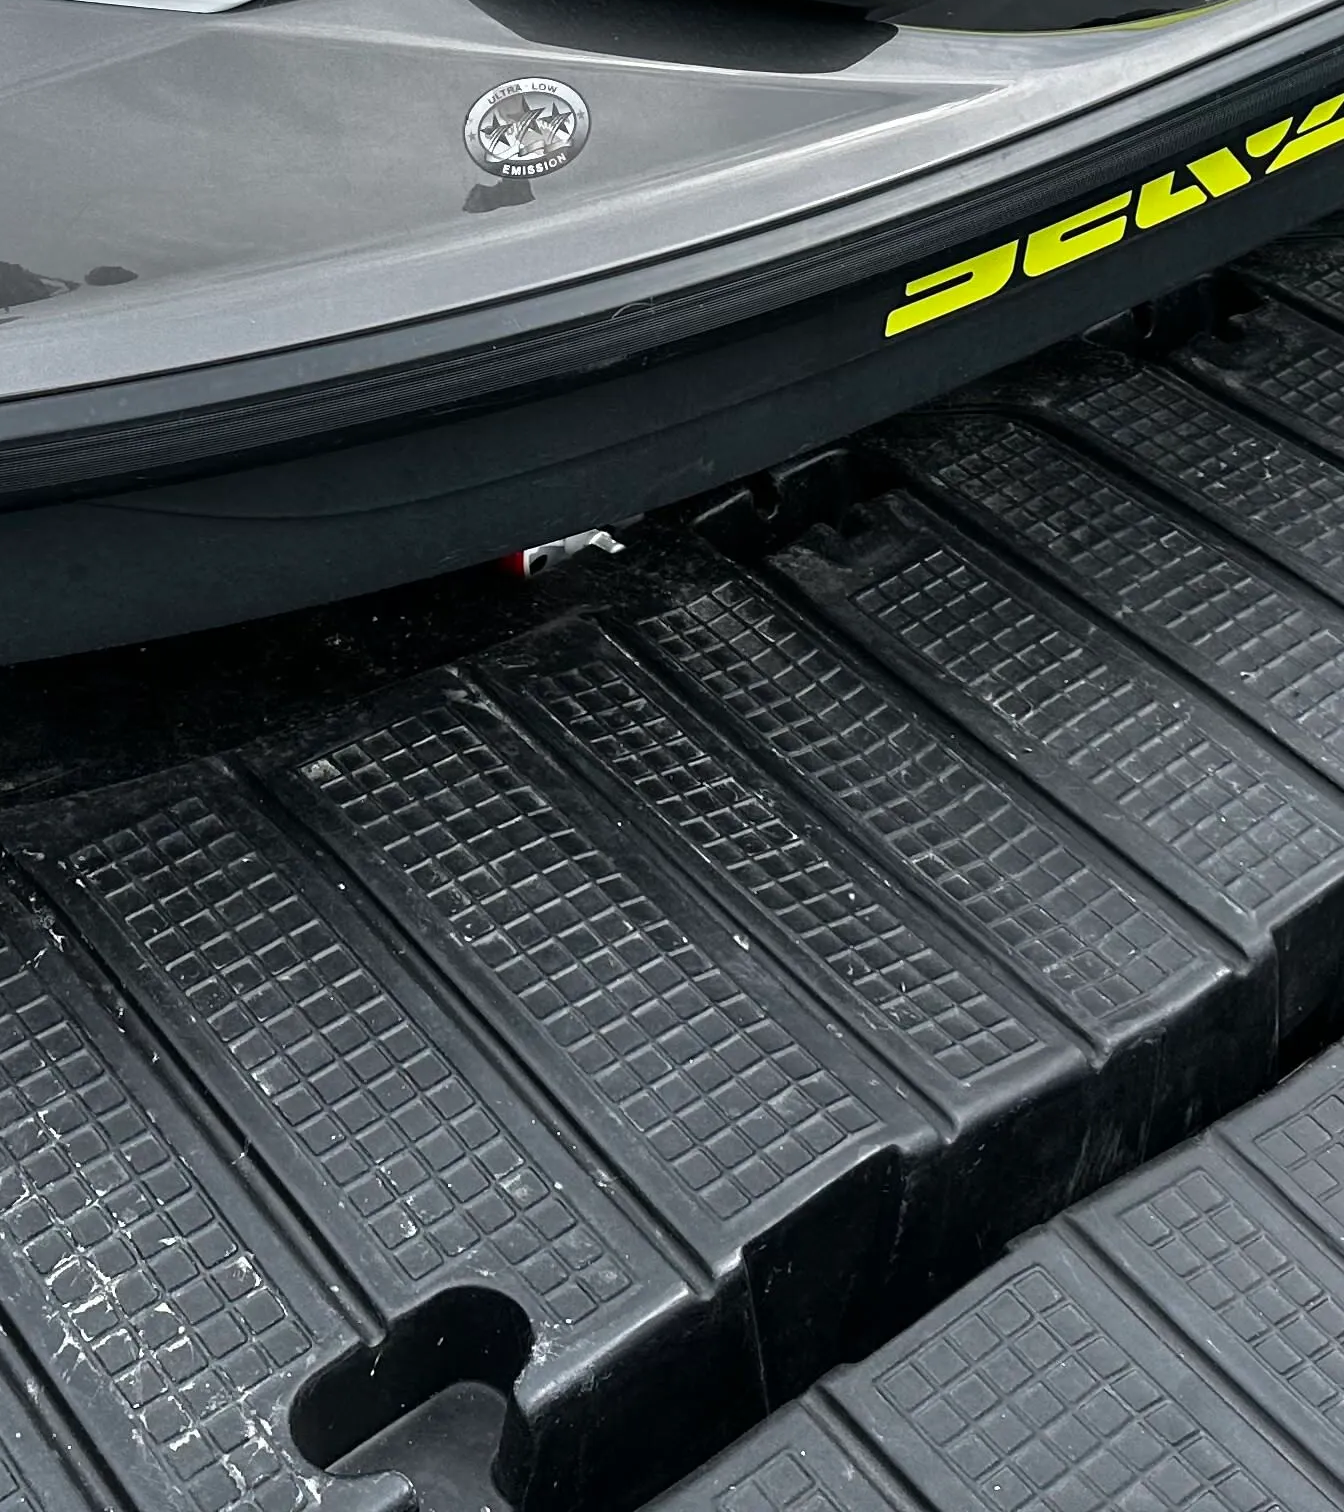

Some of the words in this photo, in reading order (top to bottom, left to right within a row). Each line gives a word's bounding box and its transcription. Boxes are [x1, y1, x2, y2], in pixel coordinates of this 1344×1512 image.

[488, 83, 523, 105] ULTRA
[531, 82, 558, 93] LOW
[502, 153, 567, 176] EMISSION
